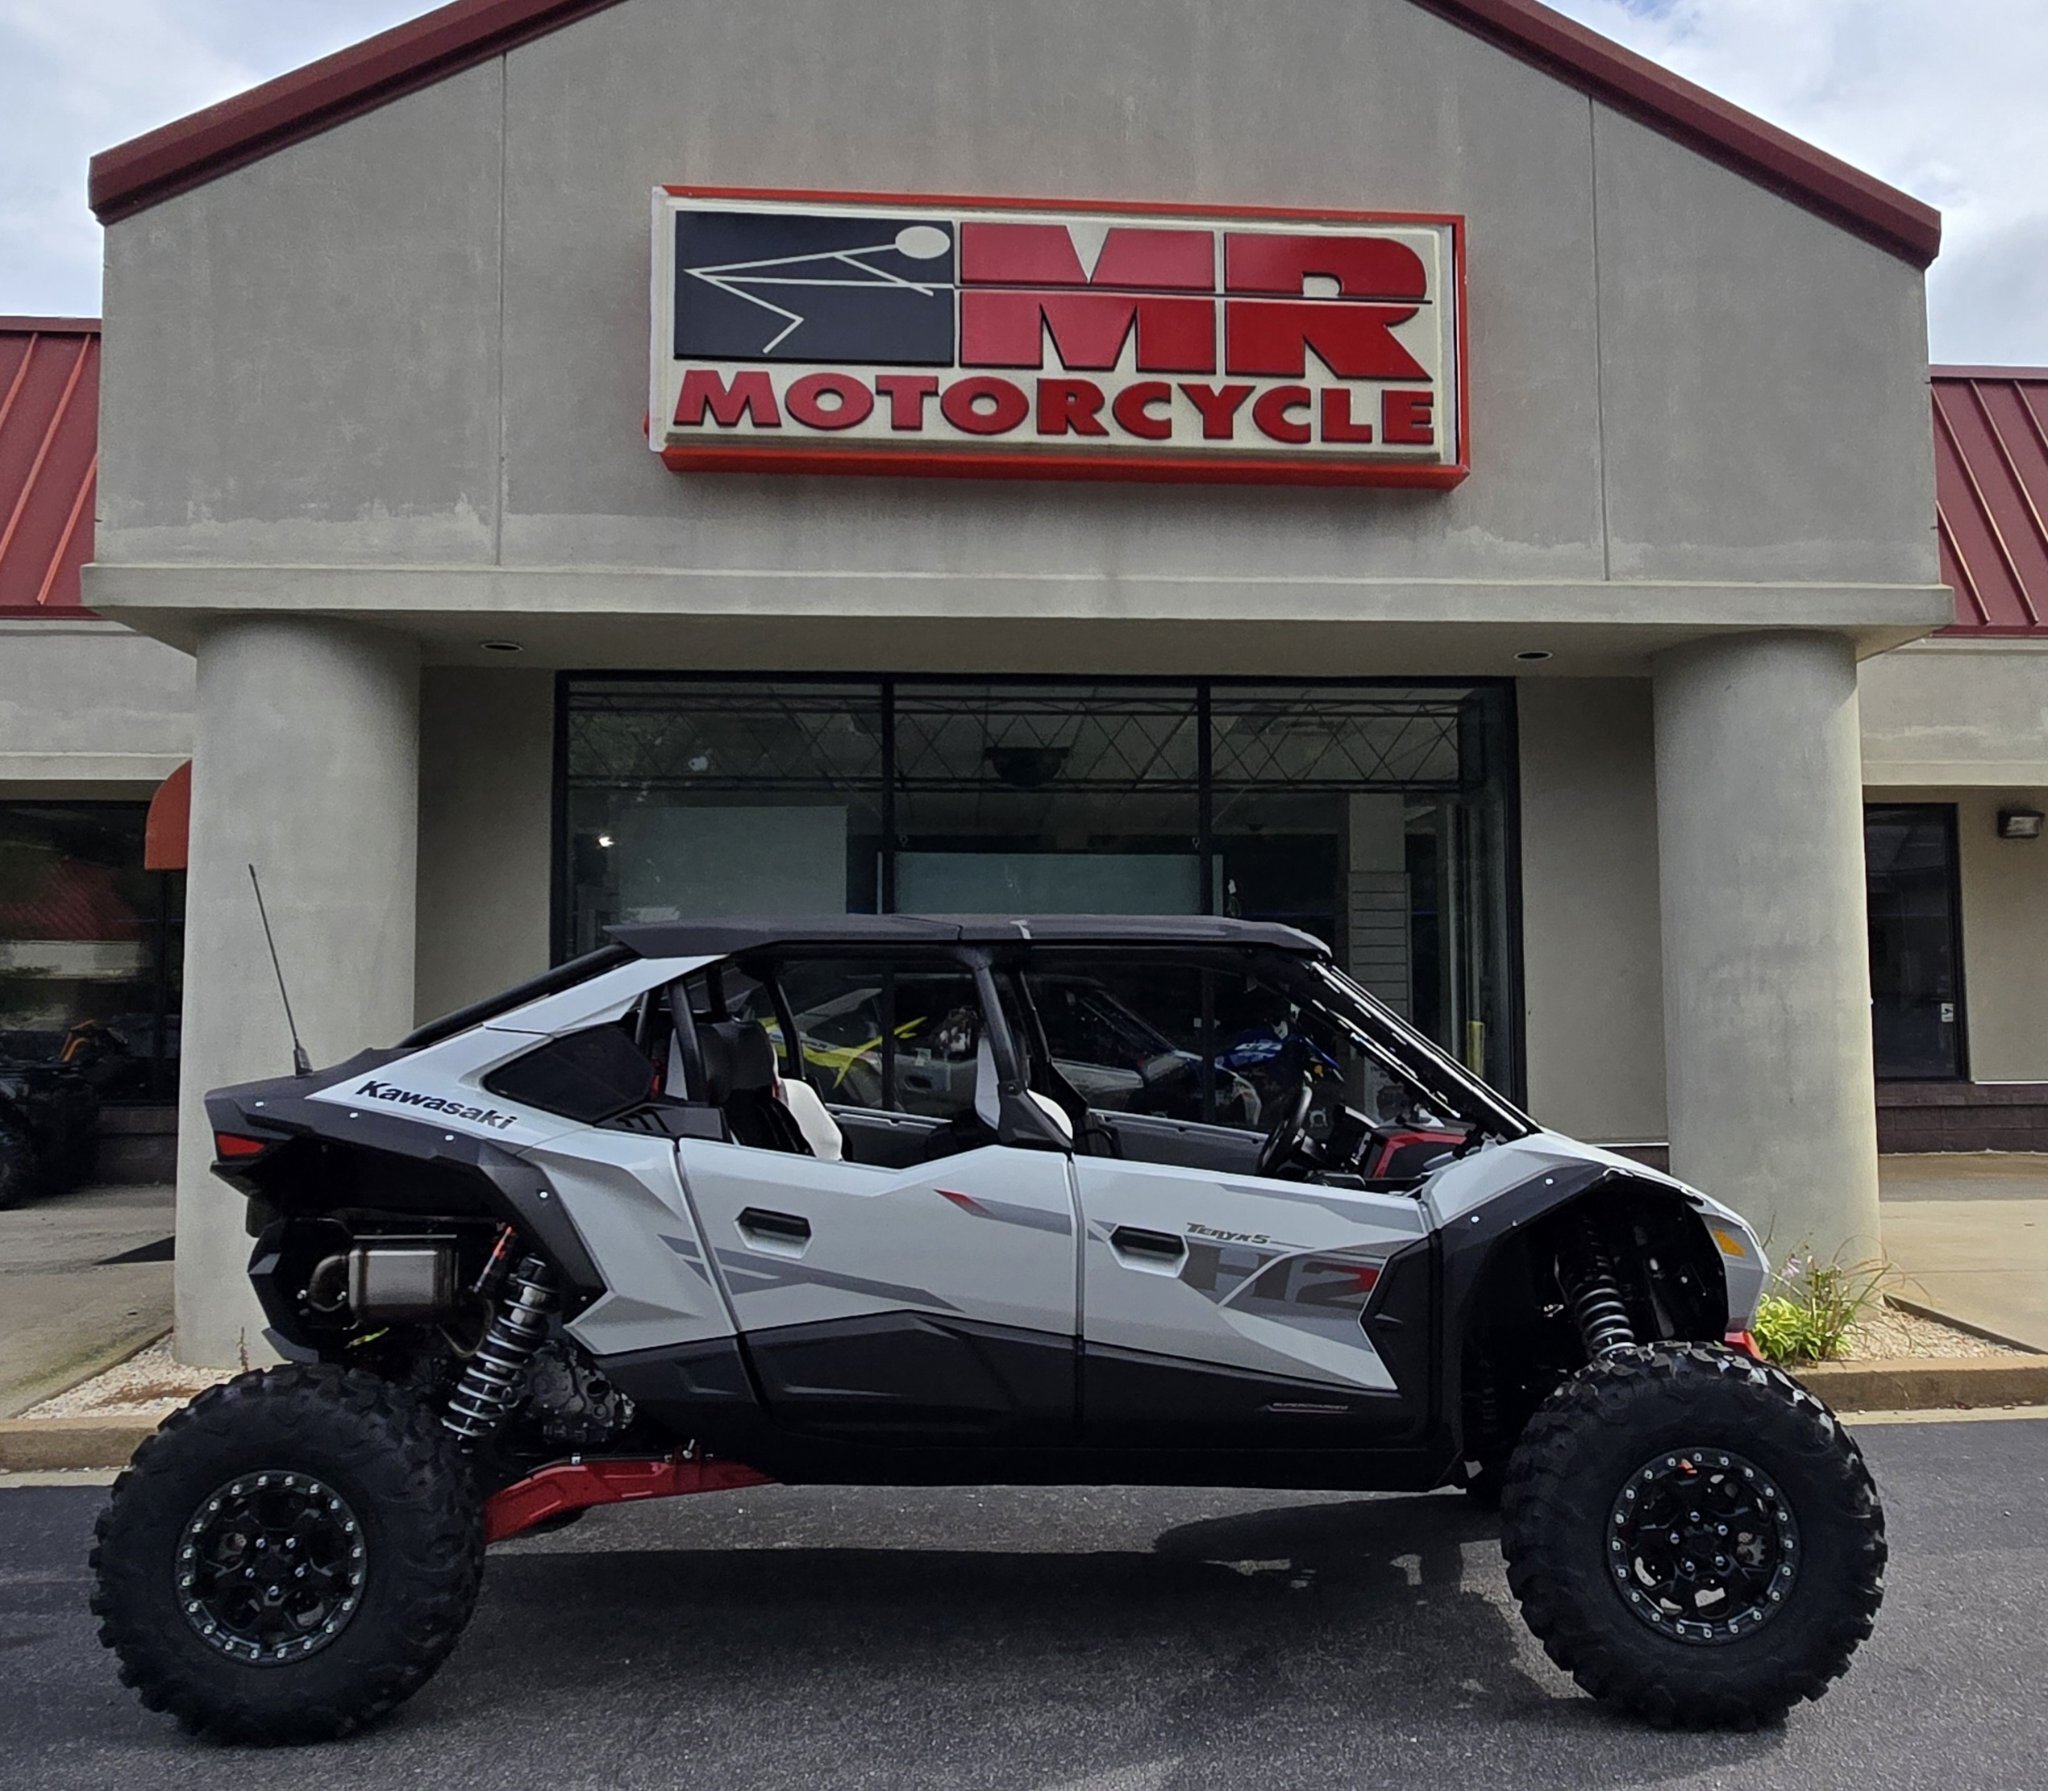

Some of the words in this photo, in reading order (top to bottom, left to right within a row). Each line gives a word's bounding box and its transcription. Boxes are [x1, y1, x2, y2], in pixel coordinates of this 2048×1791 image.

[959, 222, 1433, 382] MR
[672, 369, 1434, 445] MOTORCYCLE
[355, 1080, 517, 1130] Kawasaki
